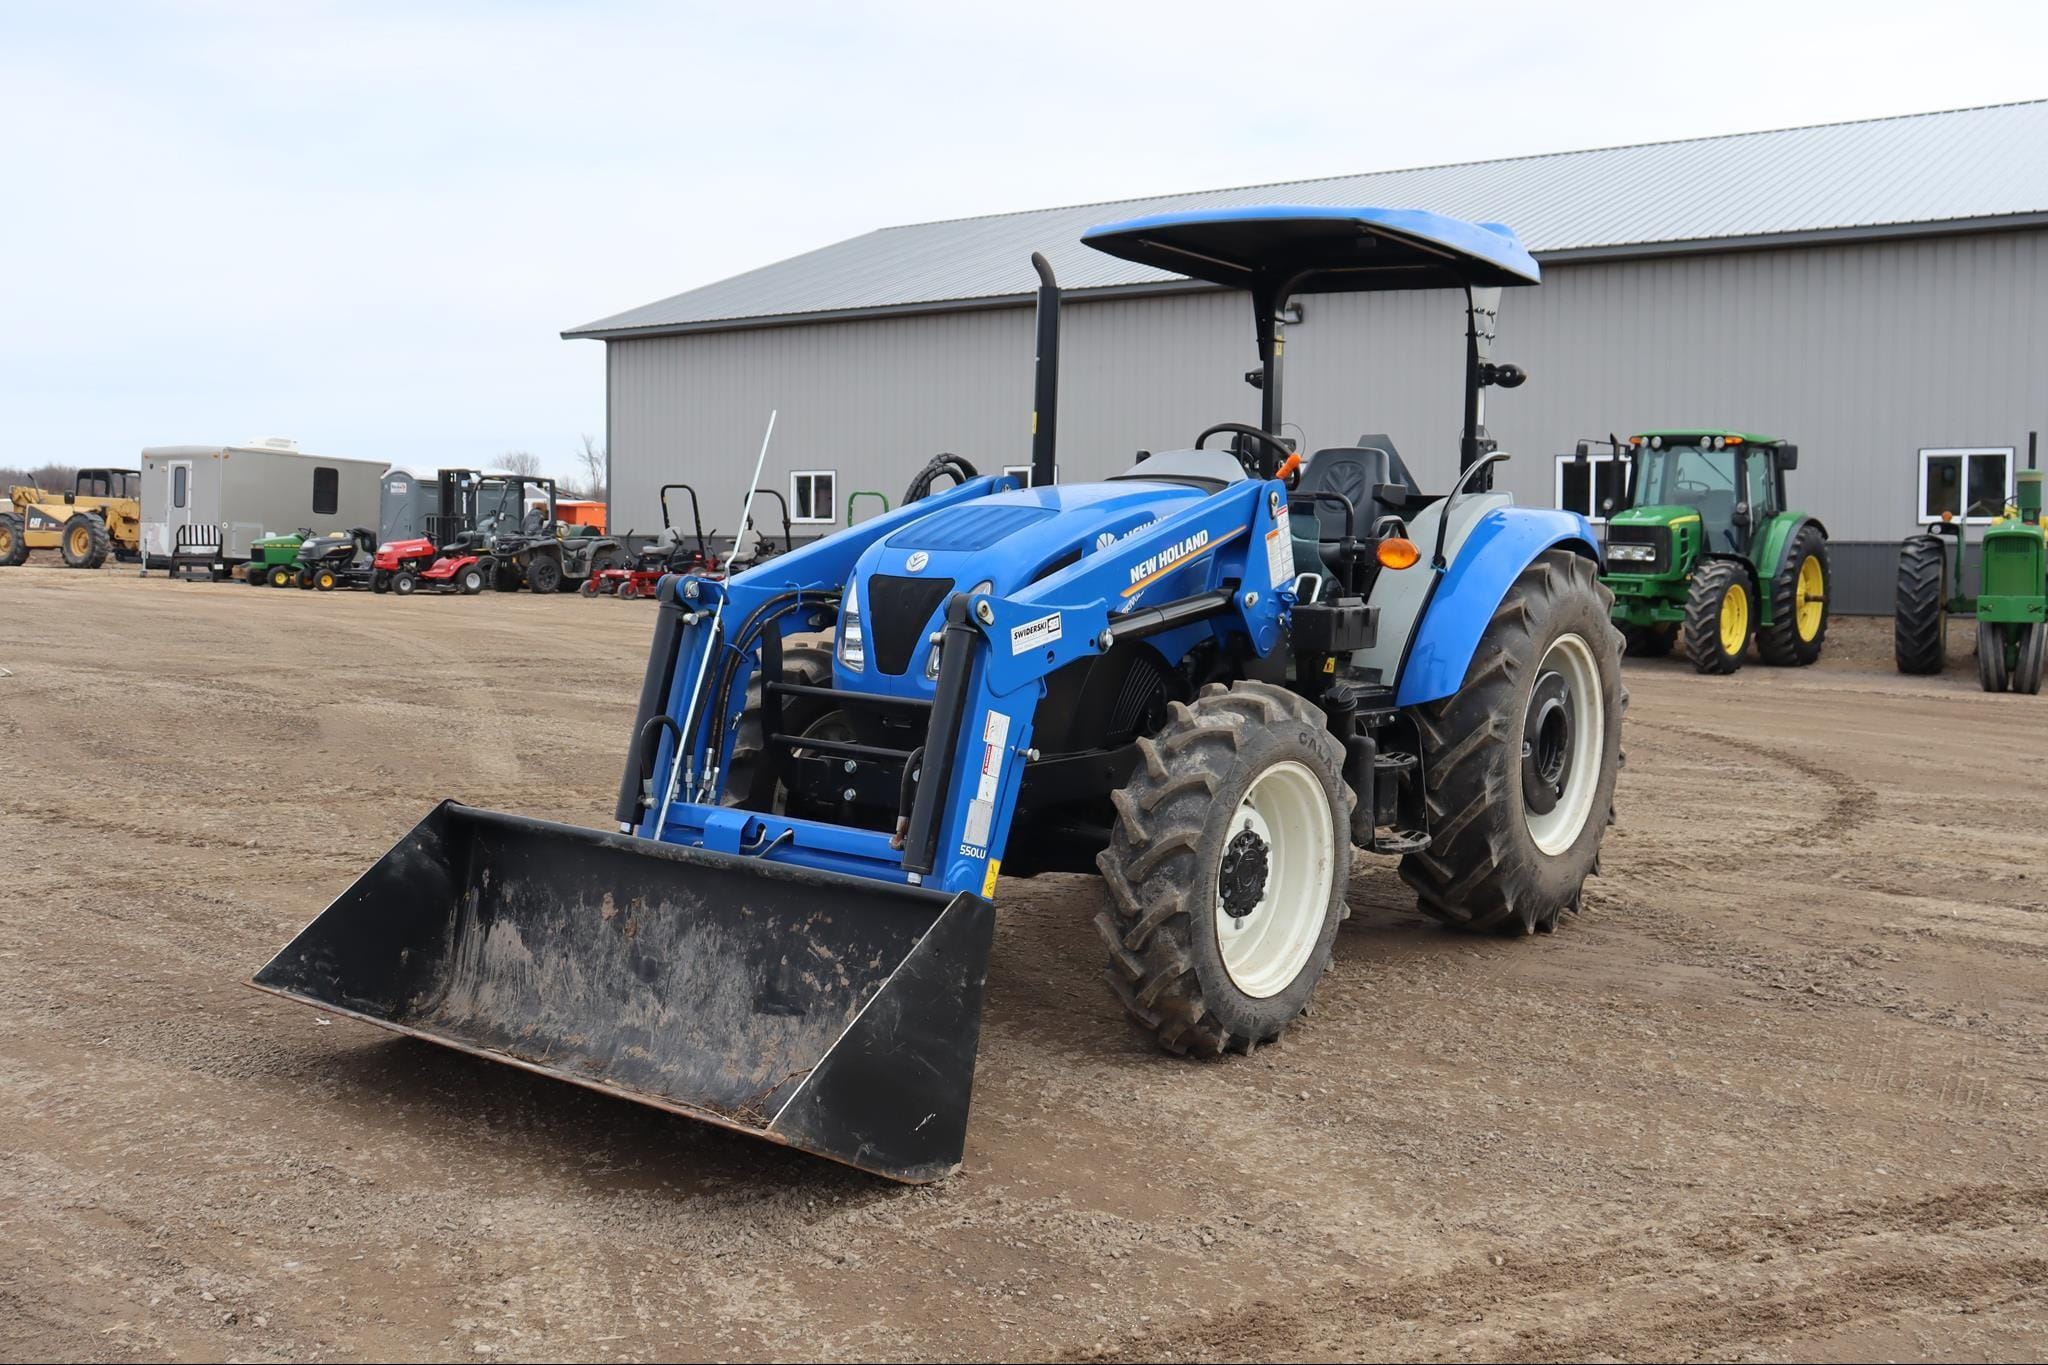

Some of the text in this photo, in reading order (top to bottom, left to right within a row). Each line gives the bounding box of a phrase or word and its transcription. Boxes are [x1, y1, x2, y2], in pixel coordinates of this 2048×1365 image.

[1130, 529, 1209, 584] NEW HOLLAND
[1014, 621, 1047, 640] SWIDERSKI
[960, 844, 987, 859] 550LU
